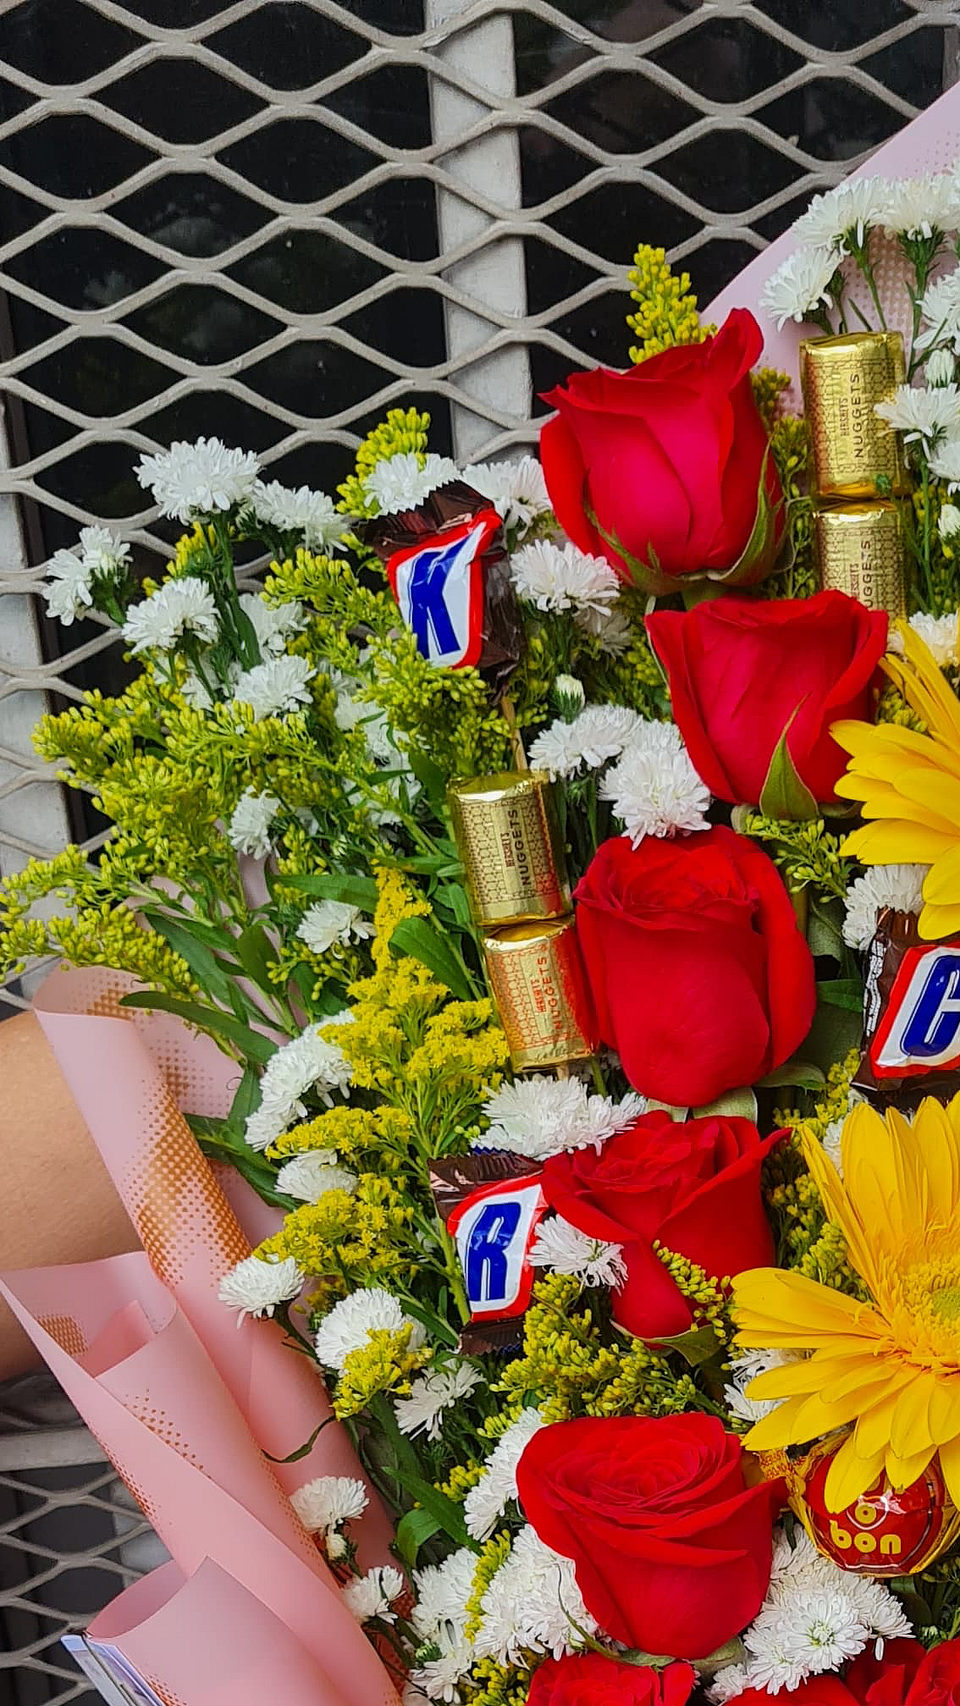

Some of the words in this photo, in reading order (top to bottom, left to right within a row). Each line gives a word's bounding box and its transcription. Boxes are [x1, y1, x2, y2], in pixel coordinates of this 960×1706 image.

[850, 374, 864, 458] NUGGETS
[408, 532, 472, 660] K
[861, 540, 873, 609] UGGETS
[508, 809, 530, 886] NUGGETS
[537, 956, 562, 1030] NUGGETS
[465, 1202, 521, 1301] R
[829, 1519, 902, 1555] bon
